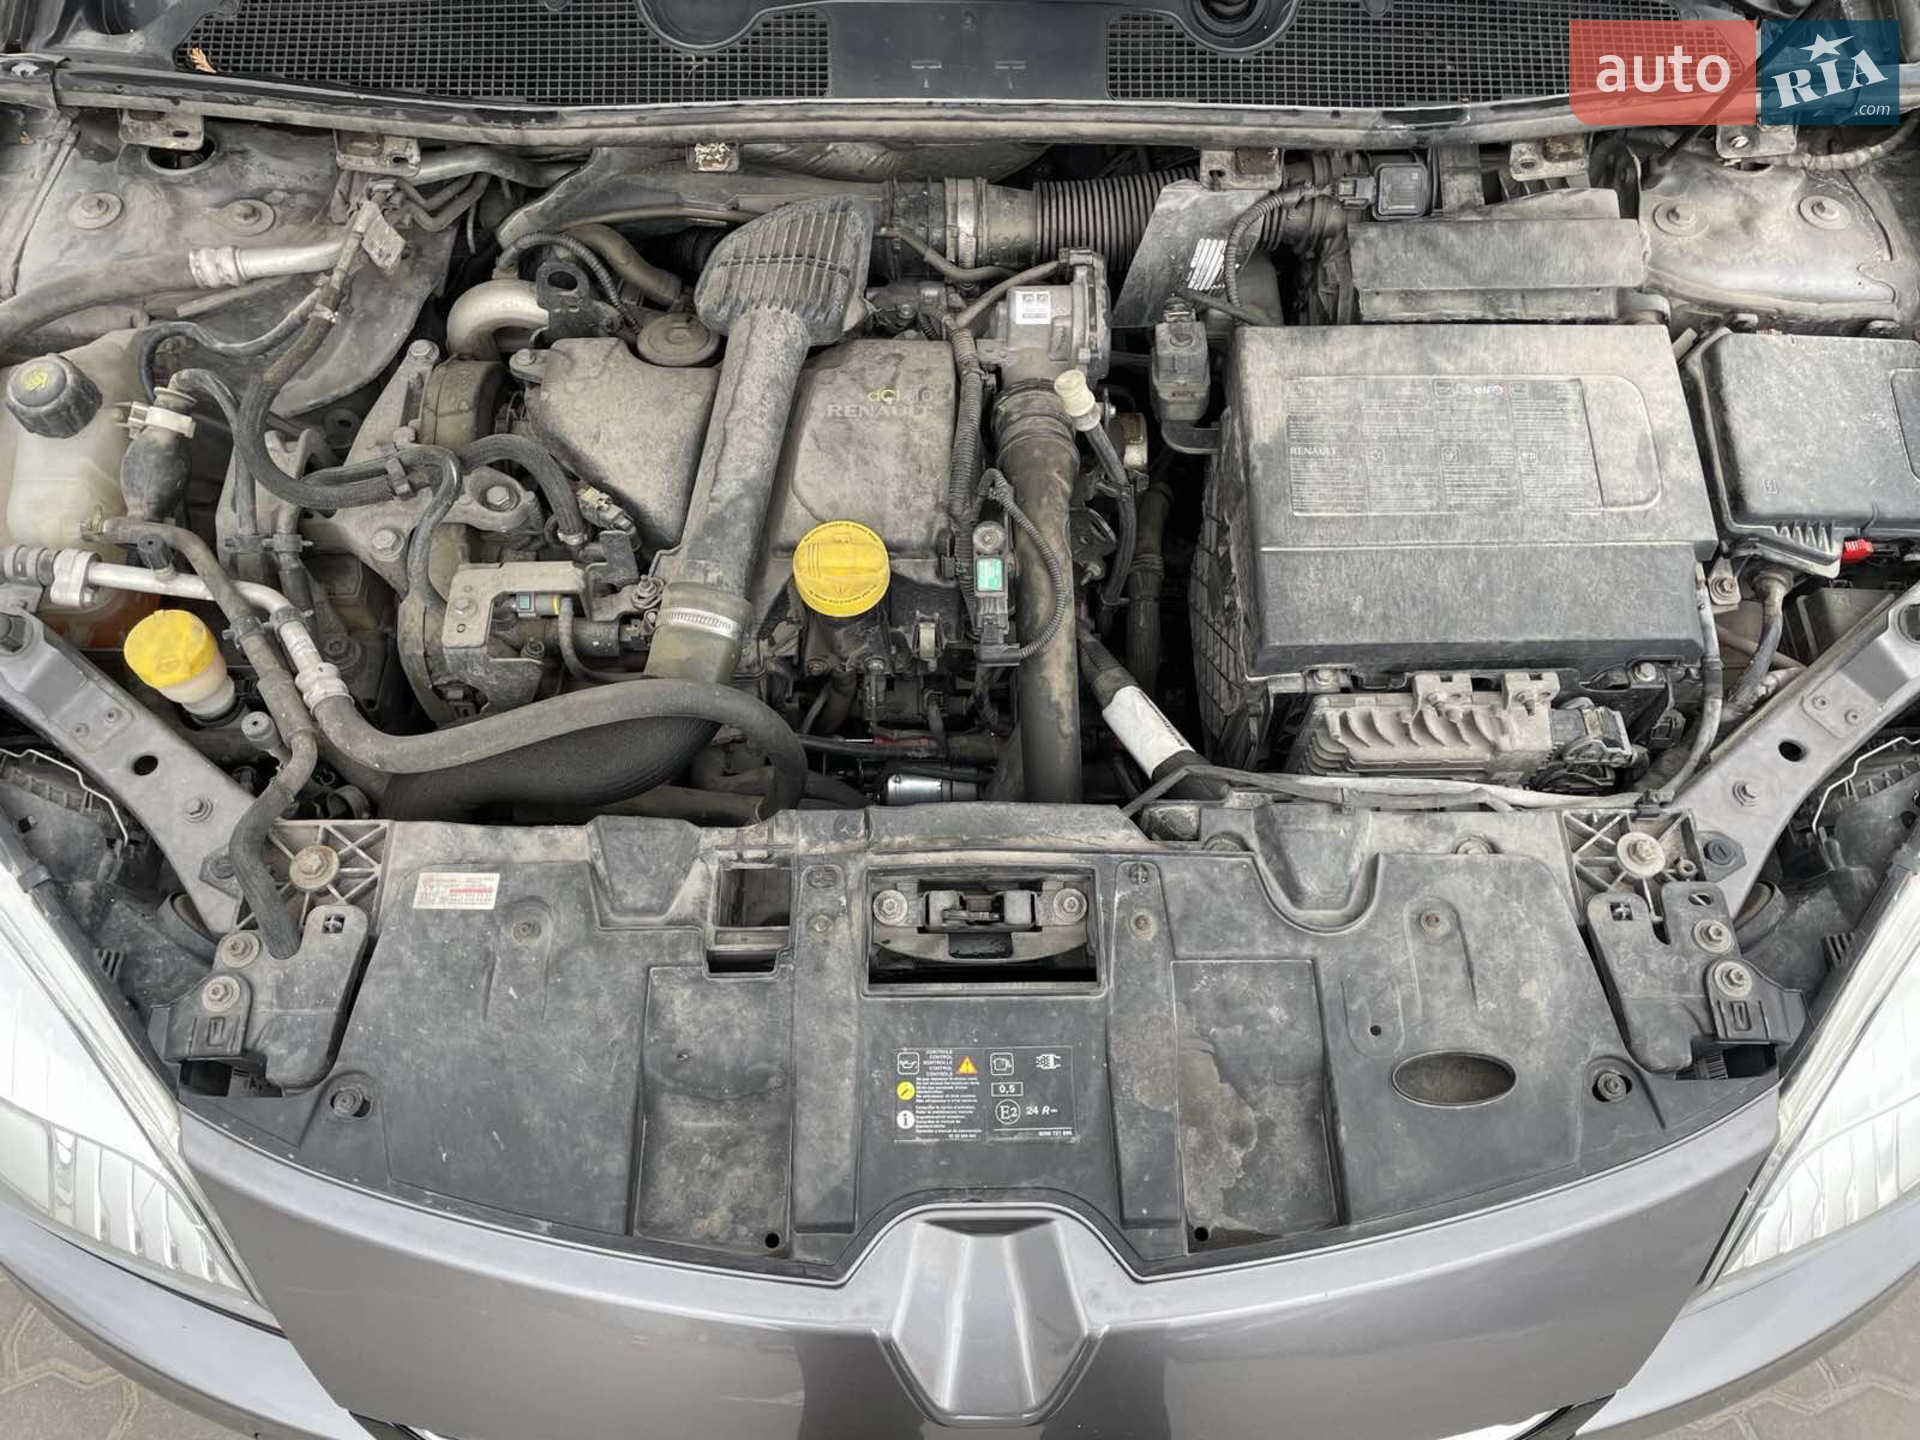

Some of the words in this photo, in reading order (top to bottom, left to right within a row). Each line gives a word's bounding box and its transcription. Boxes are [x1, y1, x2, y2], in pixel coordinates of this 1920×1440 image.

[826, 404, 932, 418] RENAULT
[998, 1084, 1015, 1094] 0,5
[1000, 1105, 1018, 1120] E2
[1026, 1105, 1039, 1115] 24
